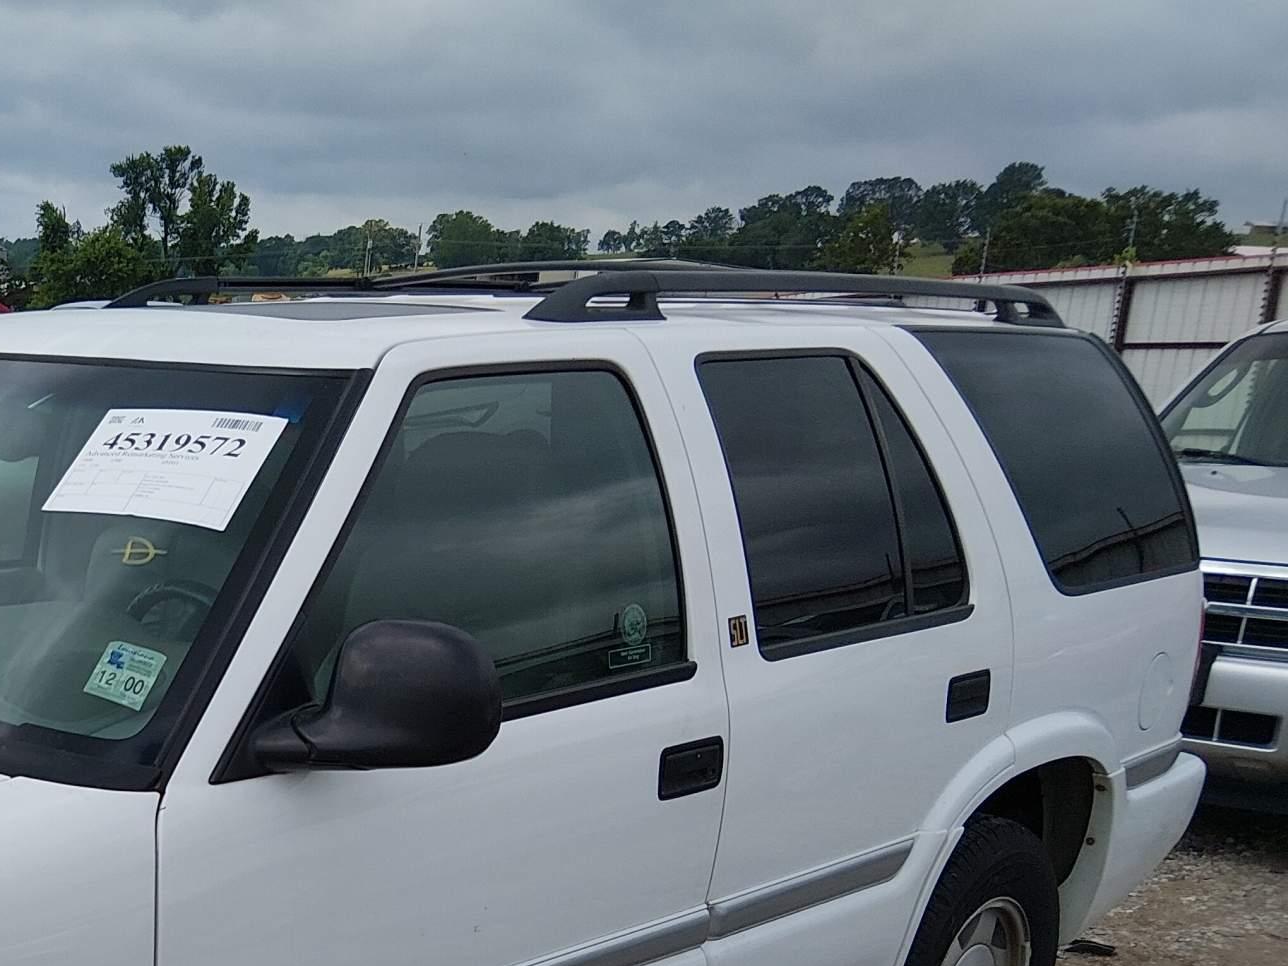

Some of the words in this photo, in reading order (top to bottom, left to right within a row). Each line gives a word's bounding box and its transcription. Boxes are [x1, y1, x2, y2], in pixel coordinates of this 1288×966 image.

[103, 432, 247, 458] 45319572
[729, 616, 748, 647] SLT
[98, 670, 117, 686] 12
[123, 676, 146, 695] 00
